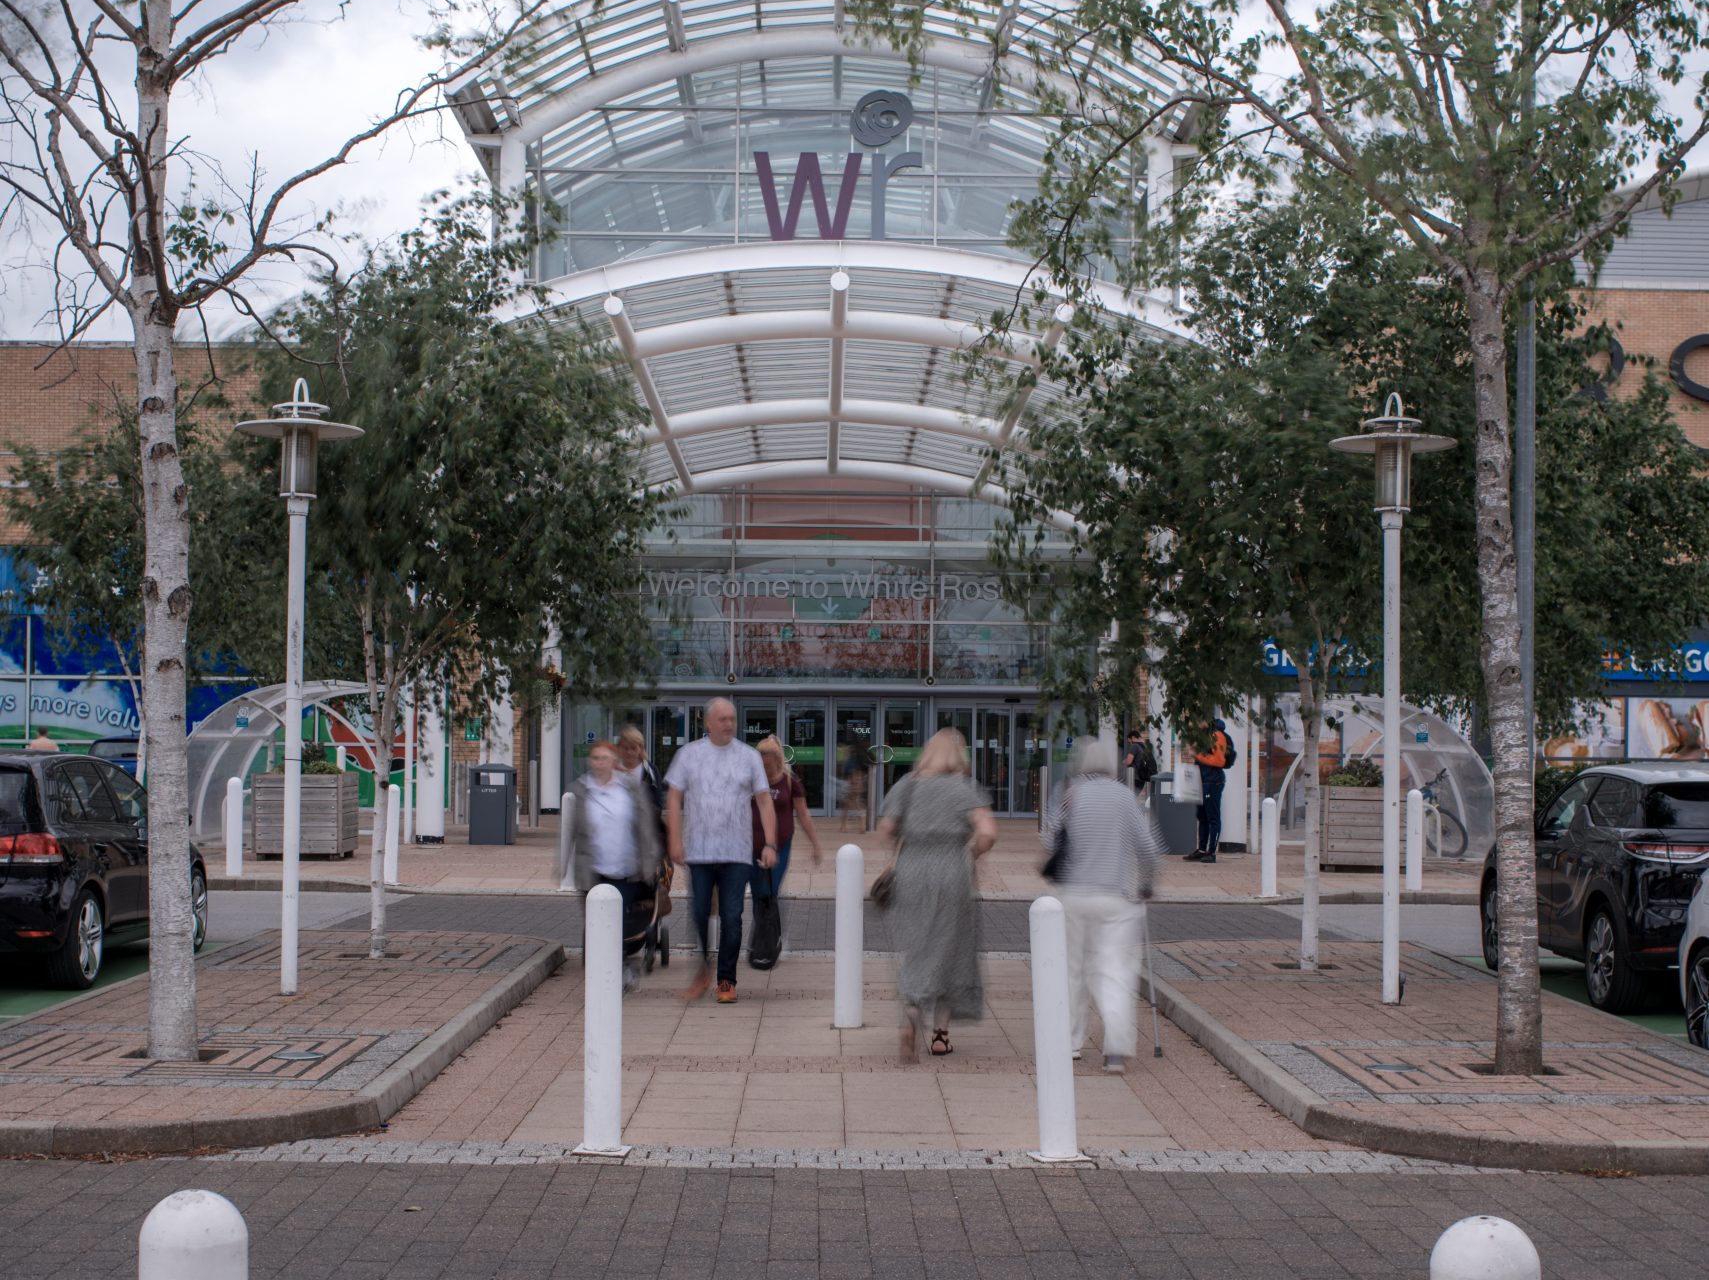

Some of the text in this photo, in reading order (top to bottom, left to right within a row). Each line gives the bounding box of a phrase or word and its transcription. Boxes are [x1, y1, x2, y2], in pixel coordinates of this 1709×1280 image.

[647, 571, 1004, 602] Welcome to White Ros
[30, 694, 91, 718] more
